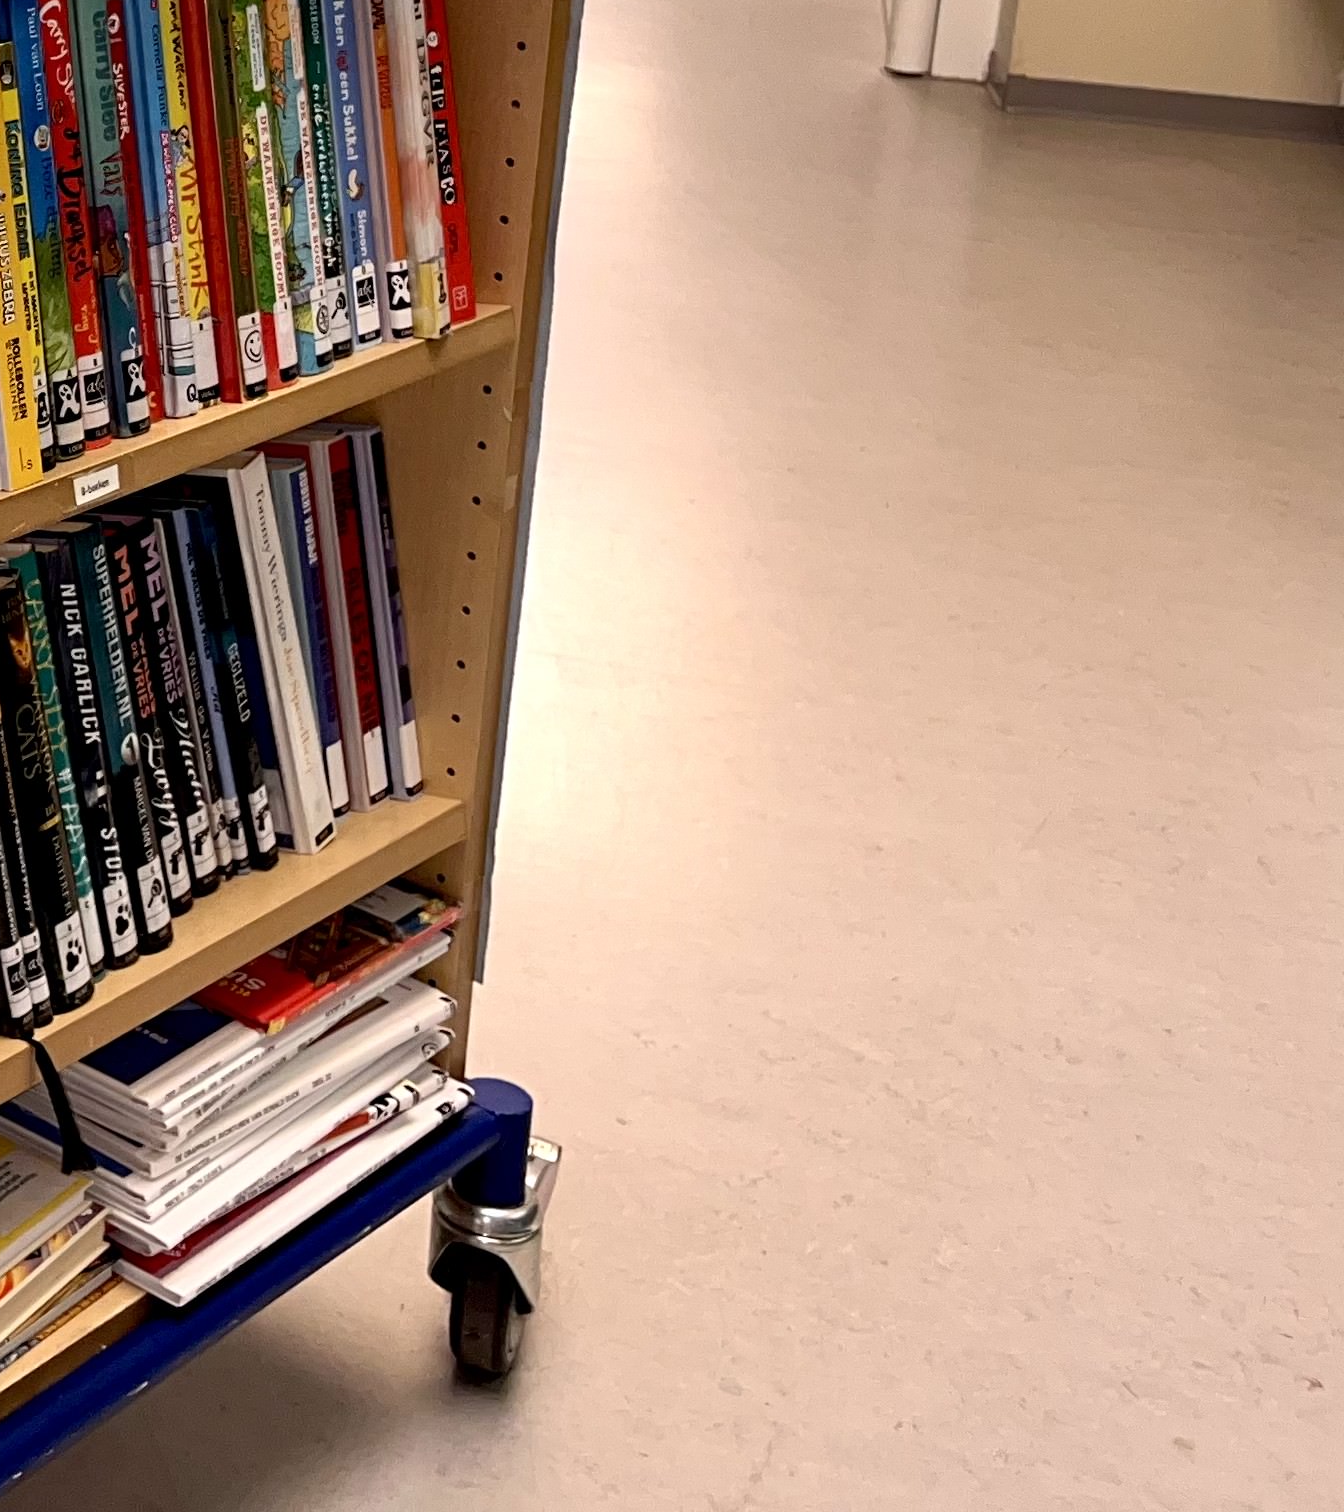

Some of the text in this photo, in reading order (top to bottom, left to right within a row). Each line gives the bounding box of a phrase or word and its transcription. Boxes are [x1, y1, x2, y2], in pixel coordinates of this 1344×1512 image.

[112, 62, 130, 140] SILVESTER
[334, 13, 346, 47] ben
[342, 104, 359, 162] Sukkel
[421, 90, 436, 168] GVR
[10, 337, 28, 419] ROLLEBOLLEN
[59, 583, 101, 745] NICK GARLICK
[92, 543, 134, 728] SUPERHELDEN.NL
[113, 544, 149, 720] MEL VRIES
